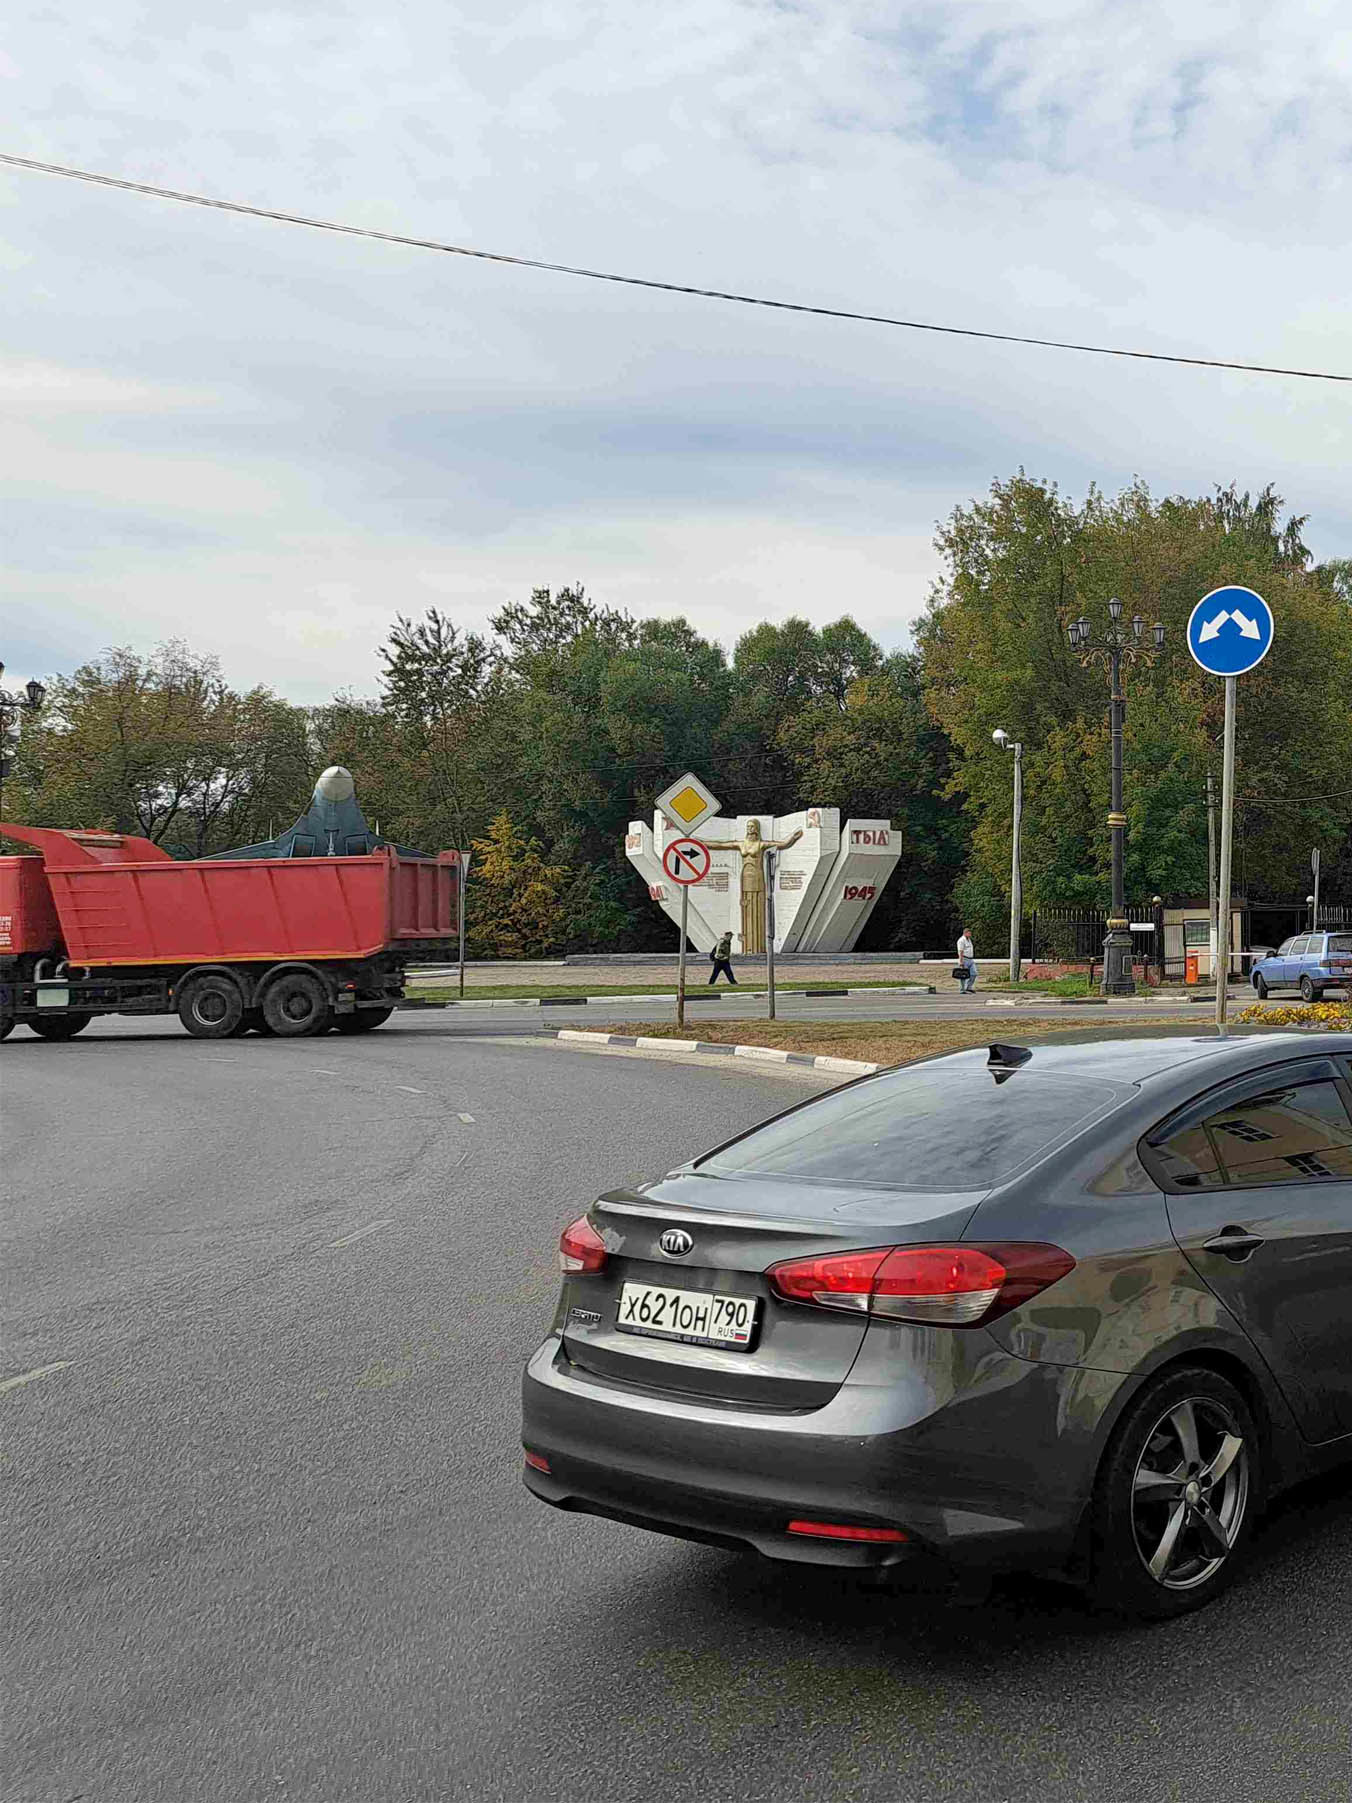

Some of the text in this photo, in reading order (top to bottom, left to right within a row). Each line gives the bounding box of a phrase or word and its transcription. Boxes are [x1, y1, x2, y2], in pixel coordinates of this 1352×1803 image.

[843, 885, 877, 900] 1945
[661, 1234, 686, 1251] KIA
[714, 1299, 748, 1328] 790
[717, 1328, 735, 1338] RUS
